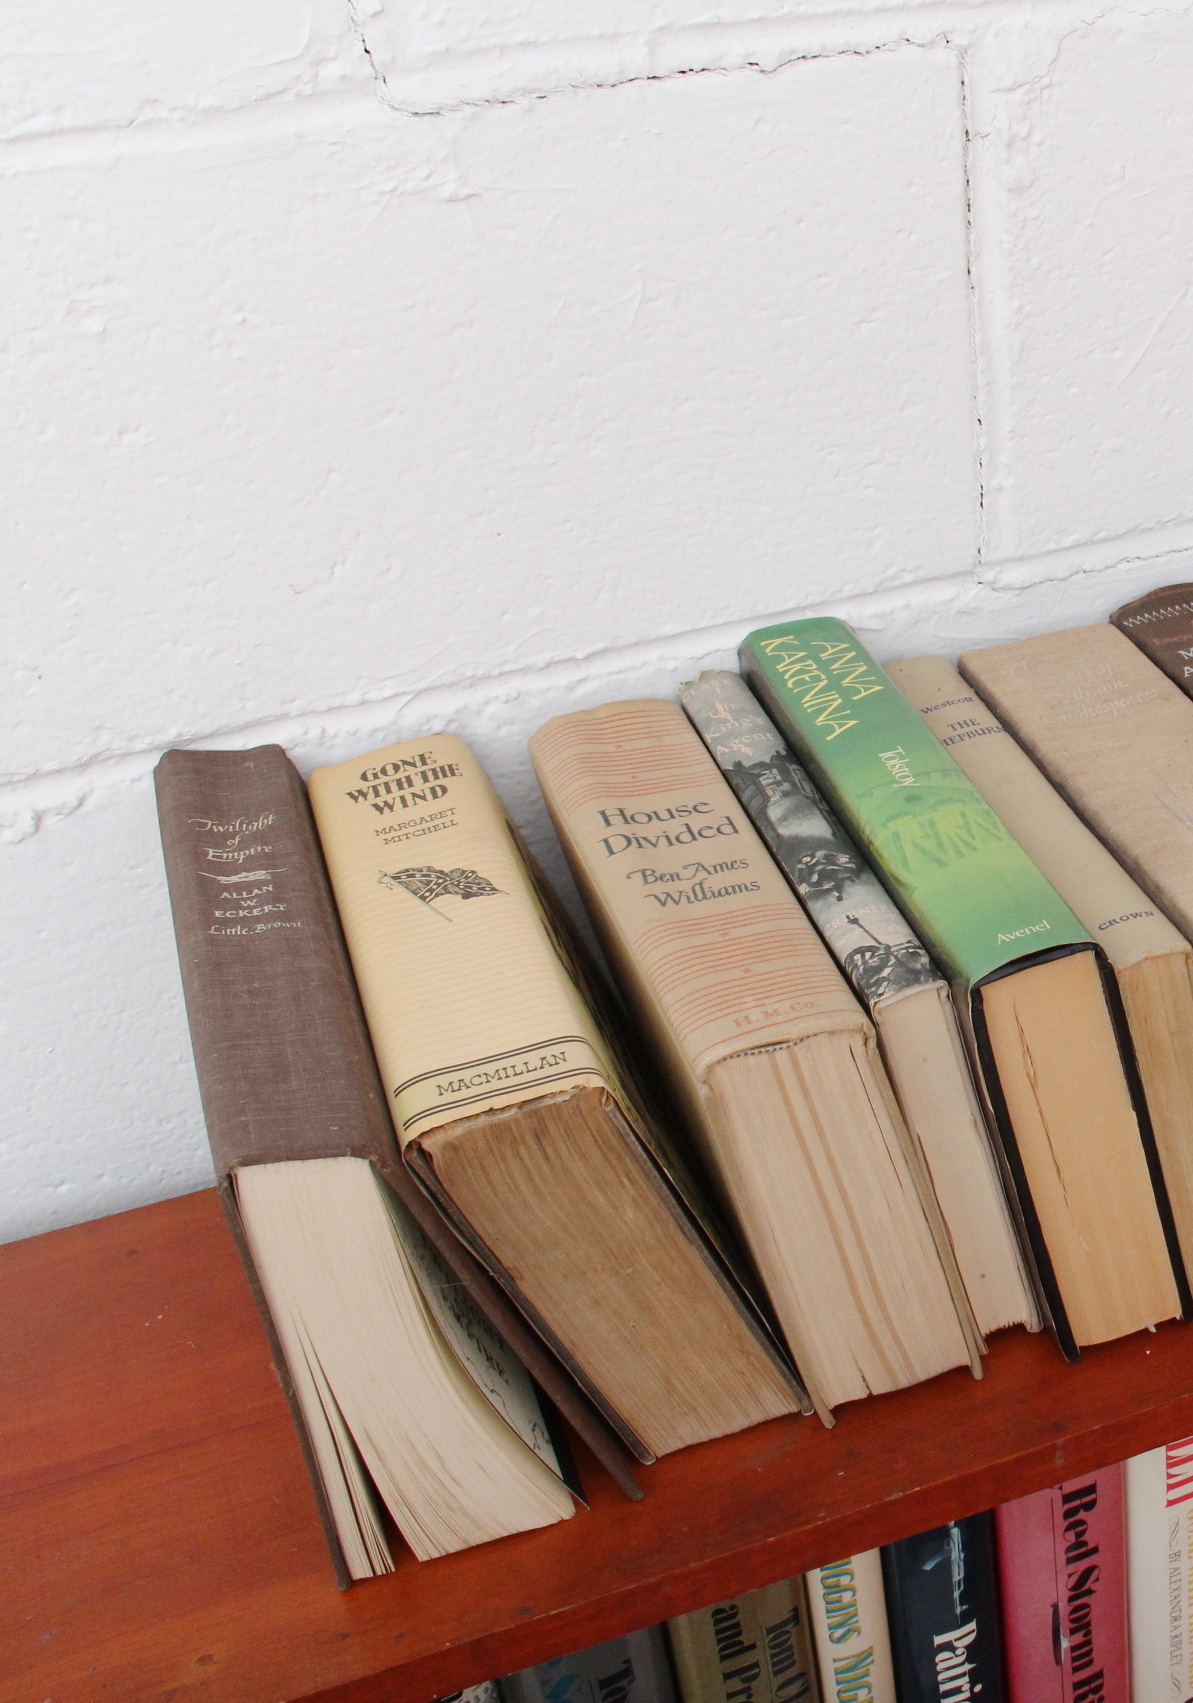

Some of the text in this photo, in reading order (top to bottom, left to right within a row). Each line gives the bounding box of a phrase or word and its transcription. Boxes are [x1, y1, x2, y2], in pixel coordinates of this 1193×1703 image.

[810, 639, 883, 701] ANNA
[759, 635, 859, 741] KARENINA
[946, 718, 981, 732] THE
[359, 751, 437, 783] GONE
[878, 746, 920, 788] Tolstoy
[344, 763, 463, 804] WITH THE
[370, 784, 449, 815] WIND
[597, 801, 715, 828] House
[188, 811, 276, 832] Twilight
[374, 807, 457, 837] MARGARET
[383, 819, 459, 846] MITCHELL
[227, 831, 250, 851] of
[598, 816, 740, 858] Divided
[203, 844, 273, 864] Empire
[625, 857, 750, 886] Ben Ames
[220, 884, 274, 899] ALLAN
[240, 898, 258, 907] W
[643, 879, 761, 907] Williams
[215, 903, 288, 918] ECKERT
[1098, 910, 1155, 931] CROWN
[996, 919, 1051, 946] Avenel
[435, 1050, 569, 1097] MACMILLAN
[1061, 1480, 1100, 1566] Red
[1066, 1565, 1100, 1675] Storm
[1168, 1550, 1183, 1667] BY ALEXANDRA RIPLEY
[711, 1604, 758, 1664] and
[764, 1607, 801, 1678] Tom
